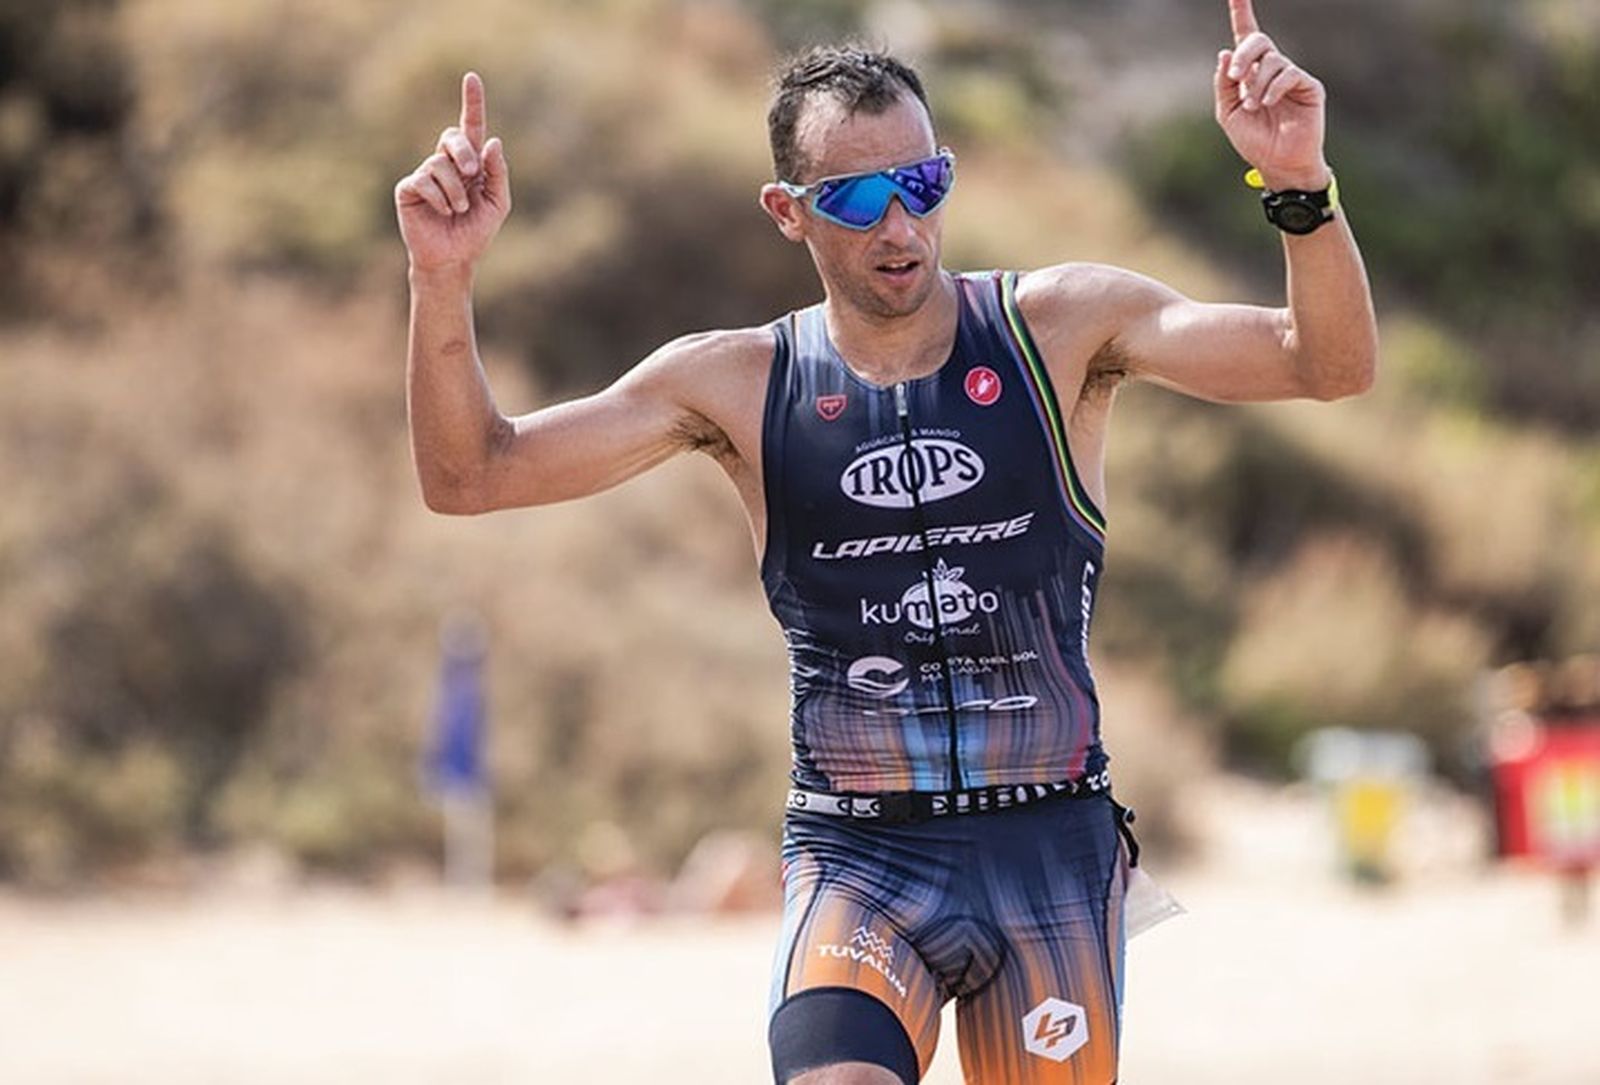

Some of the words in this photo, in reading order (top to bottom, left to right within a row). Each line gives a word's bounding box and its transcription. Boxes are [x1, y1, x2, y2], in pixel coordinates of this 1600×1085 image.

[919, 428, 961, 439] MANGO
[847, 444, 979, 496] TROPS
[812, 512, 1035, 559] LAPIERRE
[861, 591, 999, 625] kumato
[903, 622, 981, 646] Original
[919, 656, 975, 673] COSTA
[979, 656, 1009, 665] DEL
[1012, 650, 1039, 662] SOL
